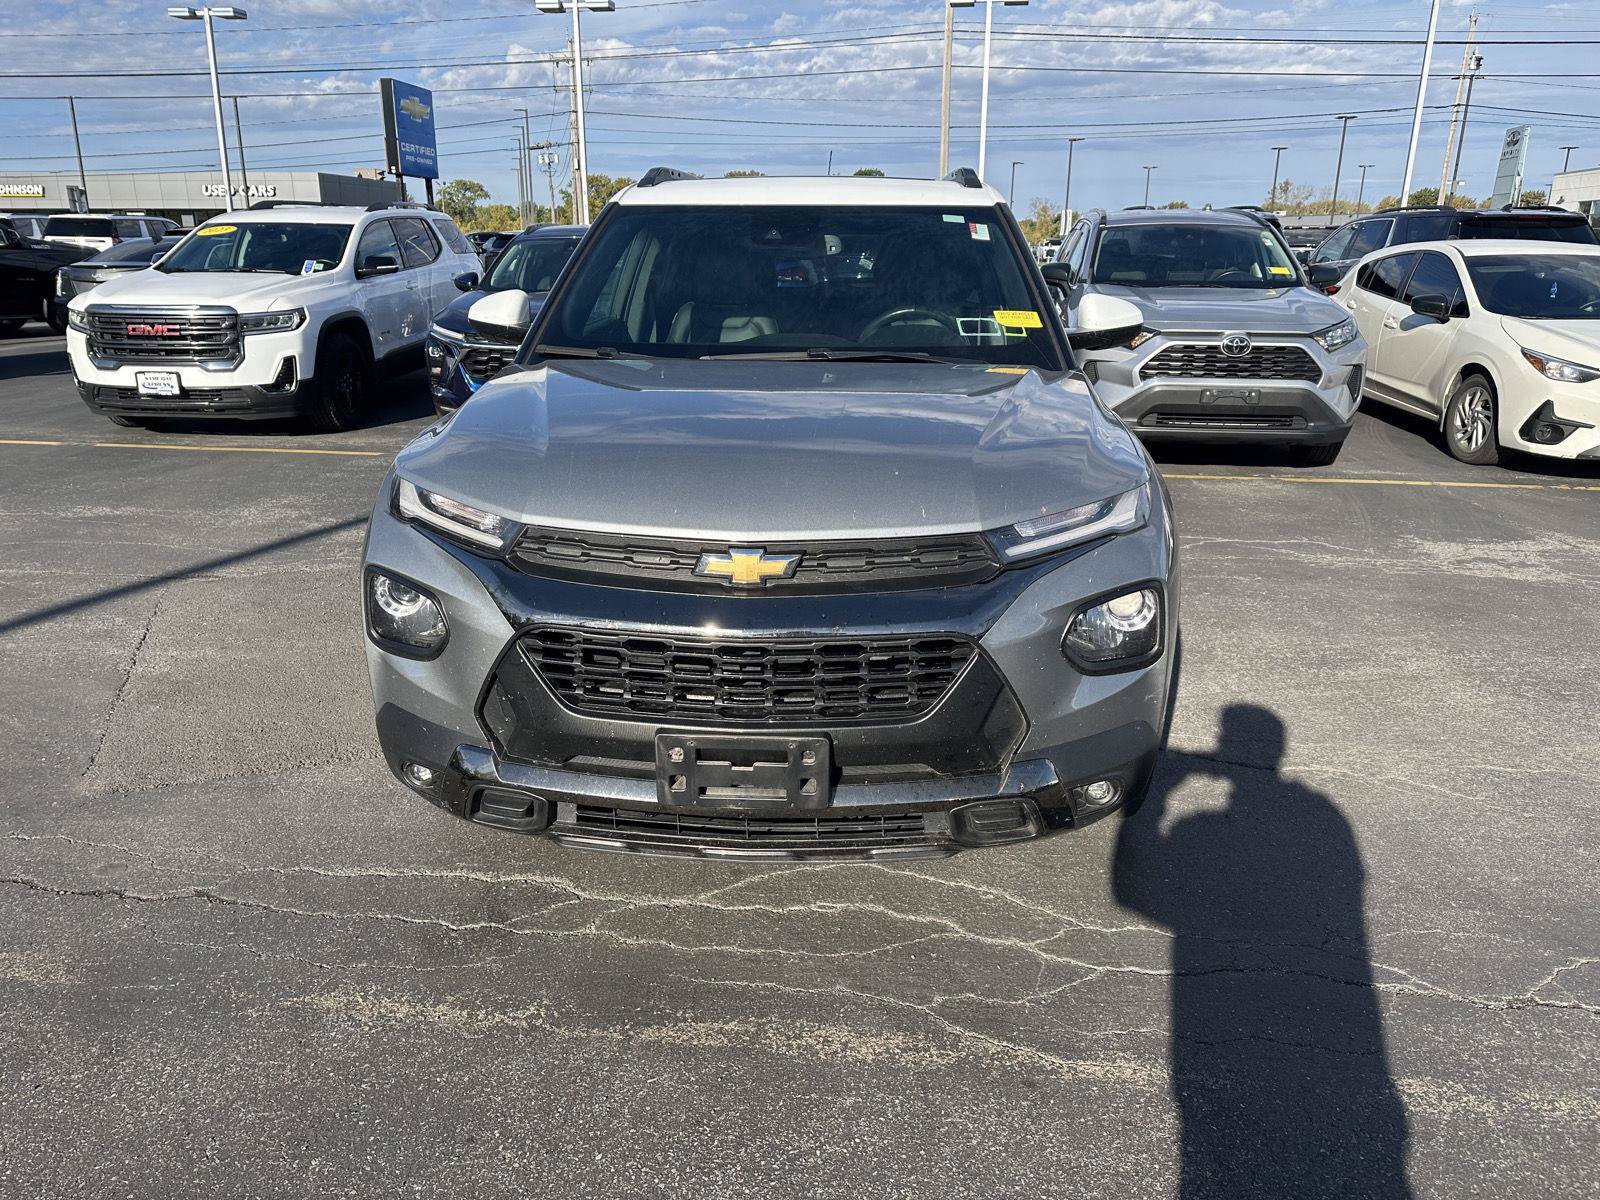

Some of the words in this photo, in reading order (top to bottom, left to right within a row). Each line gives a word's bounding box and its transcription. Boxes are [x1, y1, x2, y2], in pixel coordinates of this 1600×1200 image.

[400, 142, 436, 156] CERTIFIED
[405, 155, 433, 165] PRE-OWNED
[239, 184, 276, 197] CARS
[127, 324, 180, 336] GMC
